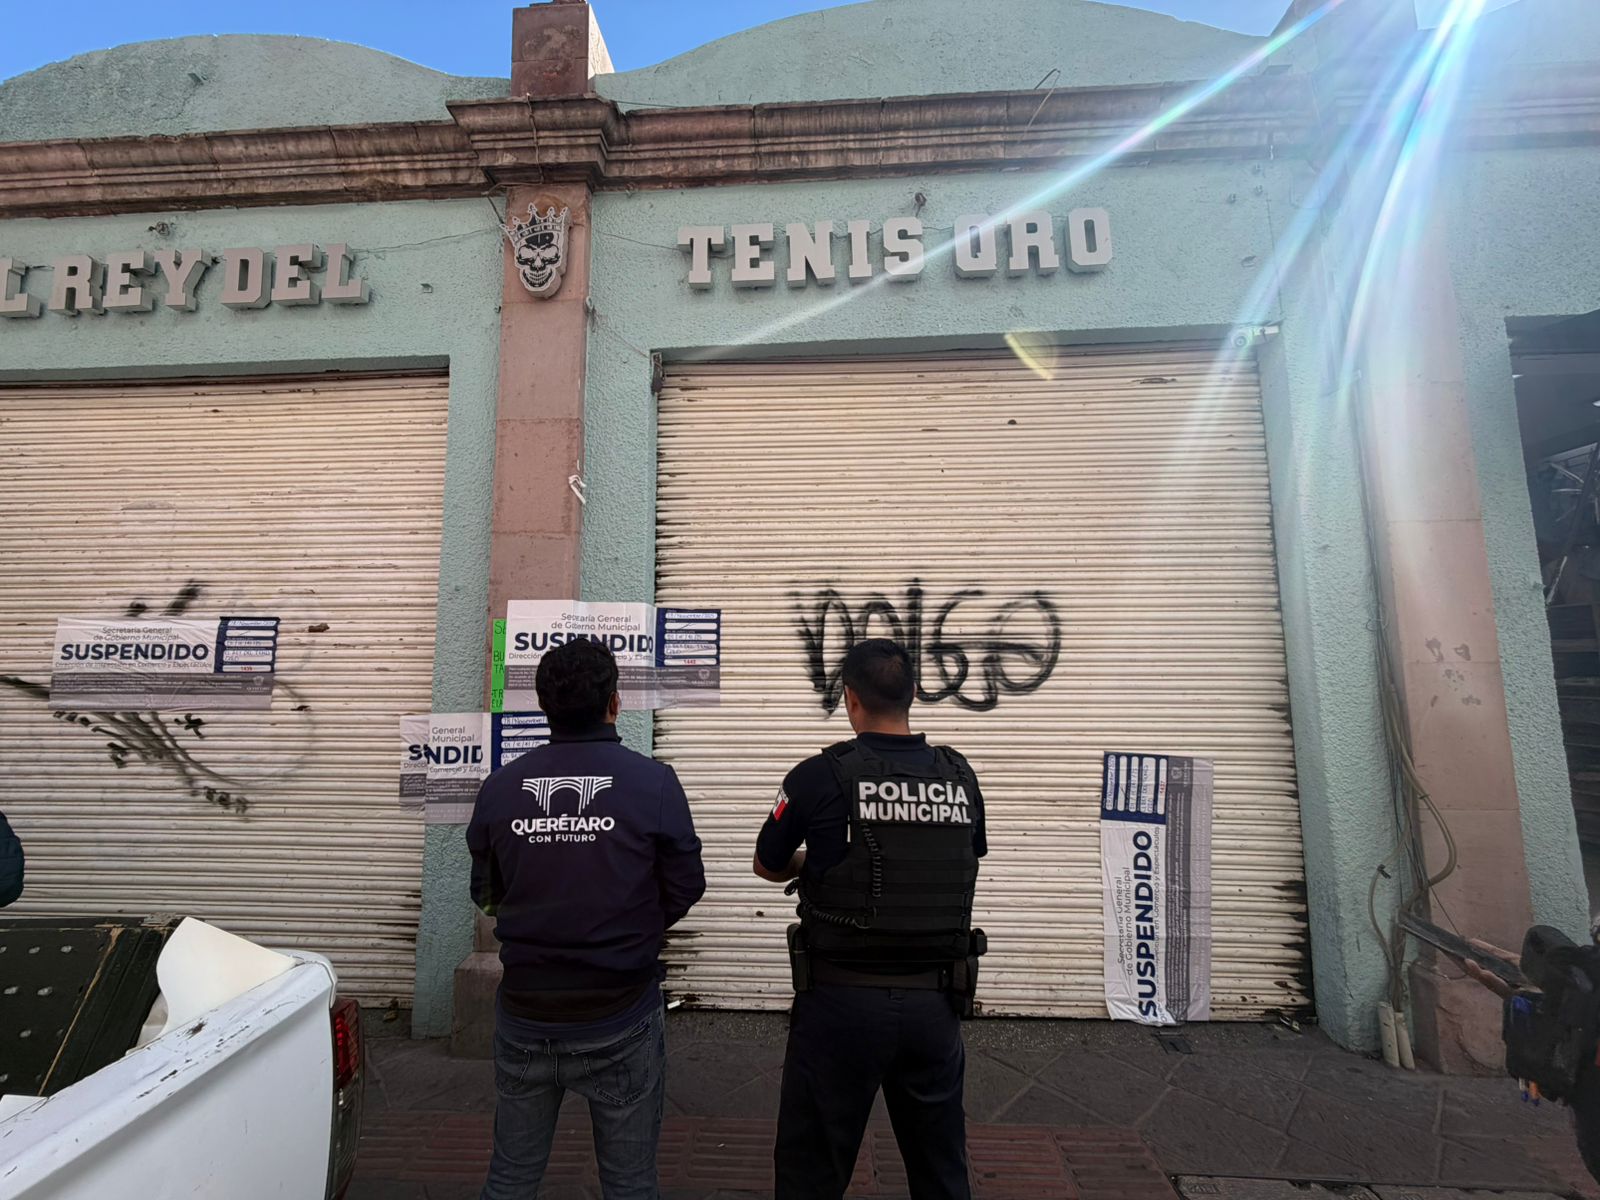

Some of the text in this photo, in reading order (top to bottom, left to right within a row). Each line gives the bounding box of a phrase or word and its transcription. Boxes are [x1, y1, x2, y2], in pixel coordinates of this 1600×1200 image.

[678, 207, 1113, 290] TENIS QRO
[50, 248, 210, 315] REY
[221, 242, 371, 308] DEL
[551, 620, 562, 629] de
[598, 623, 640, 633] Municipal
[597, 614, 631, 623] General
[142, 626, 173, 635] General
[142, 634, 179, 643] Municipal
[60, 643, 209, 660] SUSPENDIDO
[431, 726, 465, 735] General
[432, 734, 474, 744] Municipal
[858, 781, 969, 805] POLICÍA
[859, 801, 972, 824] MUNICIPAL
[511, 813, 615, 835] QUERÉTARO
[528, 833, 597, 844] CON FUTURO
[1114, 876, 1123, 914] General
[1123, 867, 1134, 976] de Gobierno Municipal
[1133, 831, 1158, 1018] SUSPENDIDO
